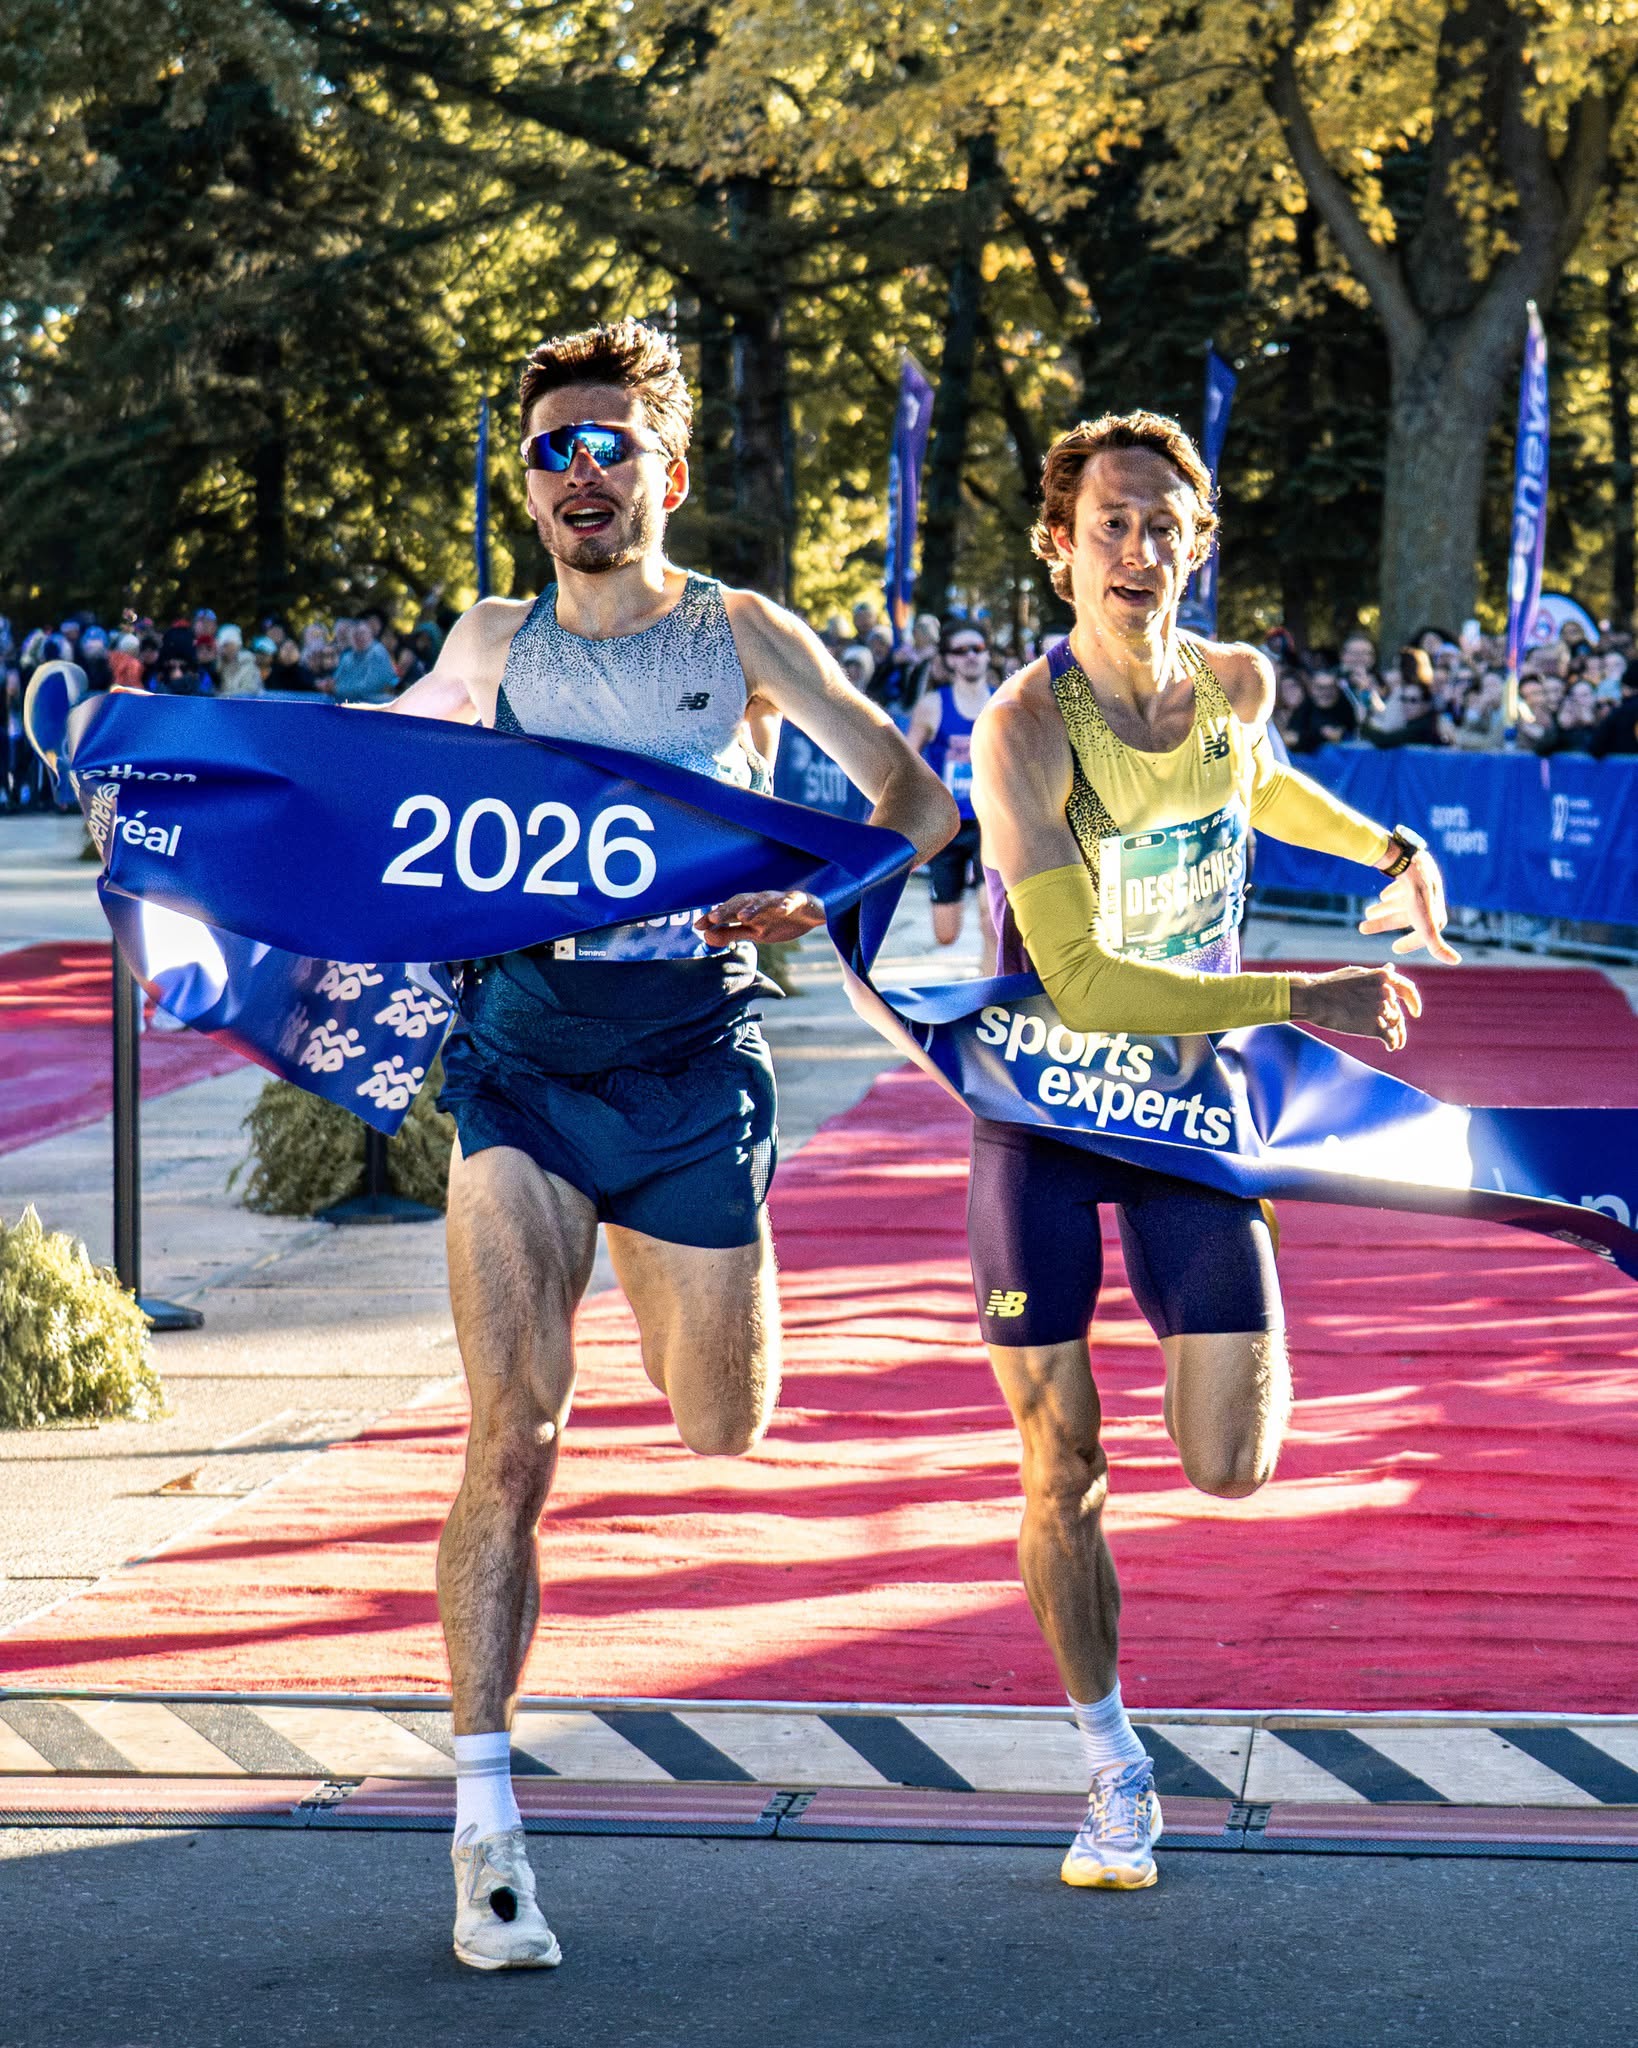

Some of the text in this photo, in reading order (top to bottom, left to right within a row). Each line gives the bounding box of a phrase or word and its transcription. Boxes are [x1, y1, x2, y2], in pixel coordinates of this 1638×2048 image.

[80, 764, 197, 782] athon
[381, 793, 657, 899] 2026
[976, 1006, 1154, 1083] sports
[1038, 1066, 1232, 1146] experts
